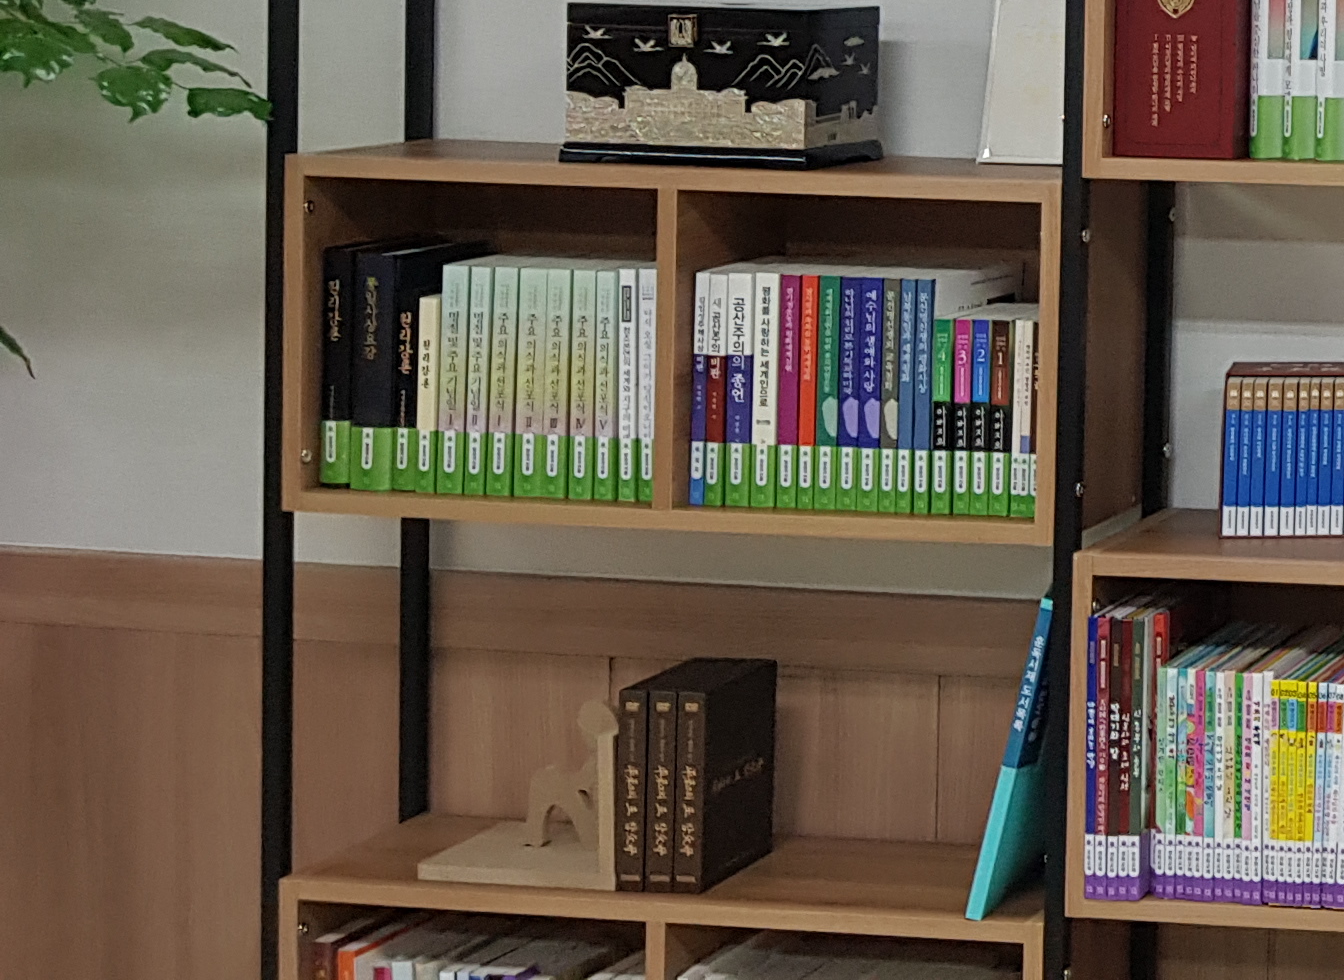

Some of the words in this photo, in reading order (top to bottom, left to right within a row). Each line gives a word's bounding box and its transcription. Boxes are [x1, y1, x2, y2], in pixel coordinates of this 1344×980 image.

[958, 348, 967, 365] 3
[976, 349, 985, 362] 2
[998, 352, 1003, 366] 1
